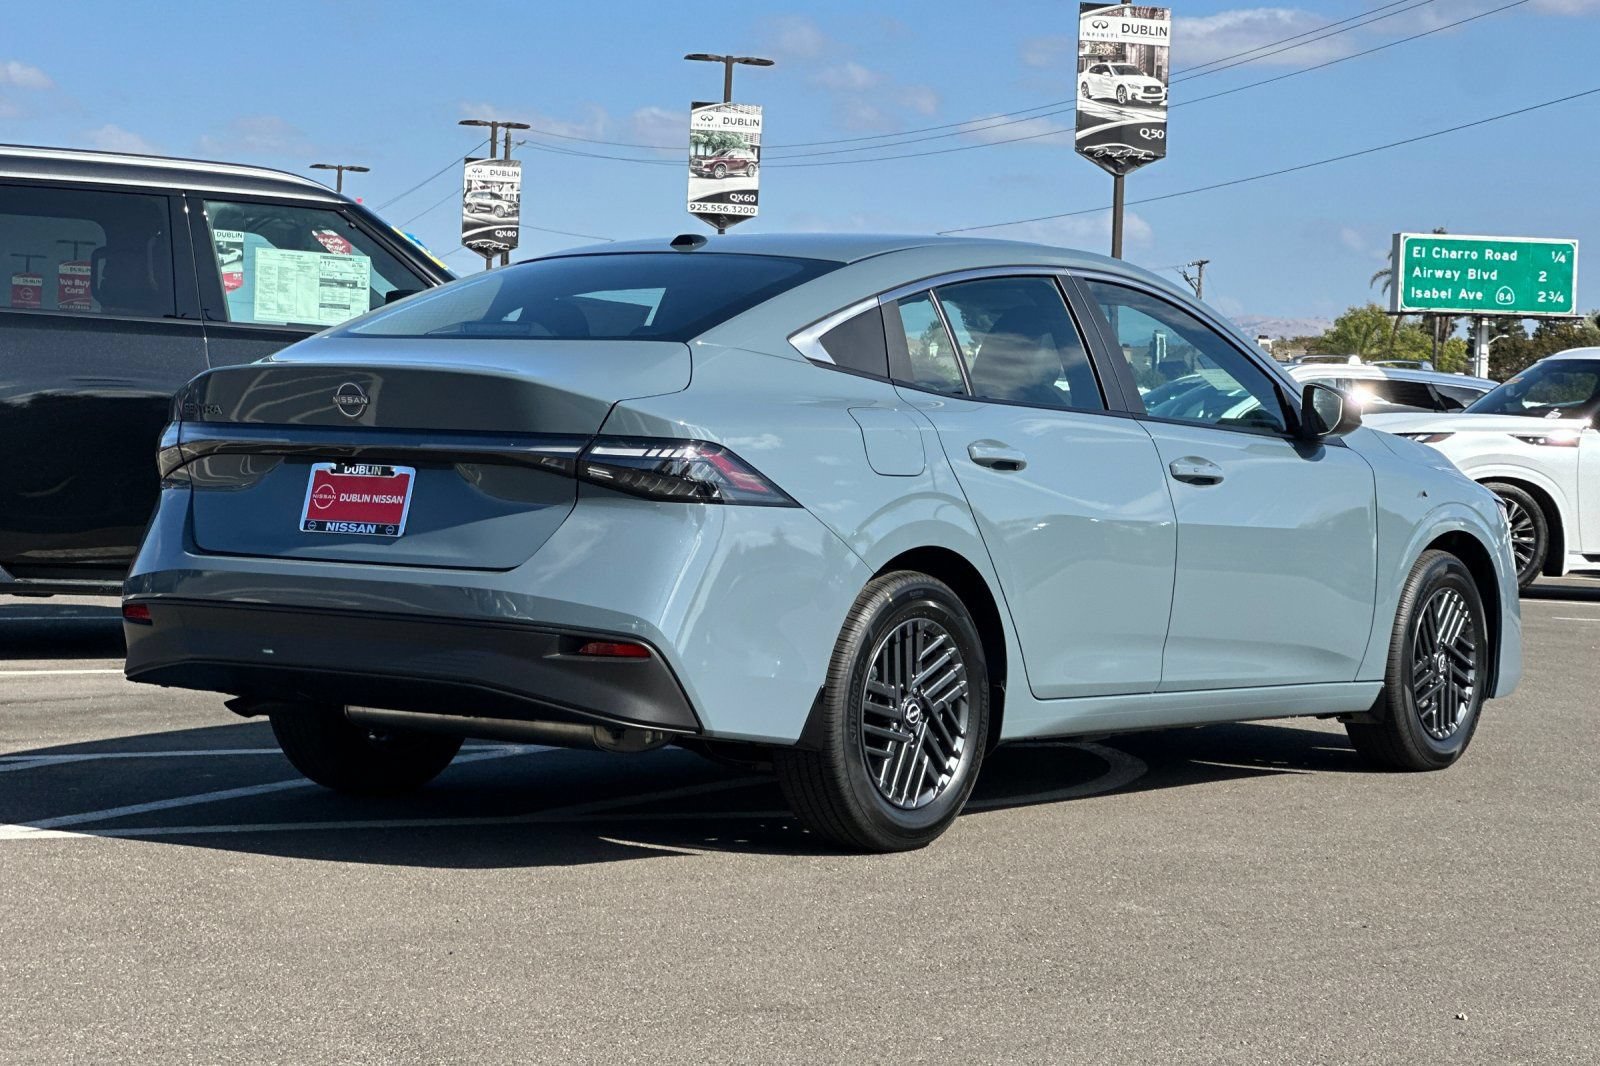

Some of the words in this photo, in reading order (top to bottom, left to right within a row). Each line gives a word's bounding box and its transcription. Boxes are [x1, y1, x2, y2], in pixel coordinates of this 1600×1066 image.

[1121, 23, 1168, 37] DUBLIN
[722, 117, 760, 127] DUBLIN
[1139, 128, 1165, 140] Q50
[489, 169, 520, 177] DUBLIN
[729, 193, 756, 203] QX60
[689, 203, 756, 214] 925.556.3200
[216, 231, 243, 239] DUBLIN
[494, 229, 517, 238] QX80
[1412, 246, 1425, 258] El
[1431, 247, 1478, 260] Charro
[1484, 249, 1518, 262] Road
[1412, 266, 1461, 281] Airway
[1467, 268, 1498, 280] Blvd
[1537, 271, 1547, 282] 2
[59, 278, 73, 286] We
[74, 279, 90, 288] Buy
[1411, 286, 1452, 299] Isabel
[1458, 288, 1483, 300] Ave
[1498, 292, 1512, 302] 84
[332, 396, 368, 404] NISSAN
[344, 465, 382, 475] DUBLIN
[339, 493, 371, 503] DUBLIN
[371, 494, 404, 504] NISSAN
[325, 522, 377, 534] NISSAN
